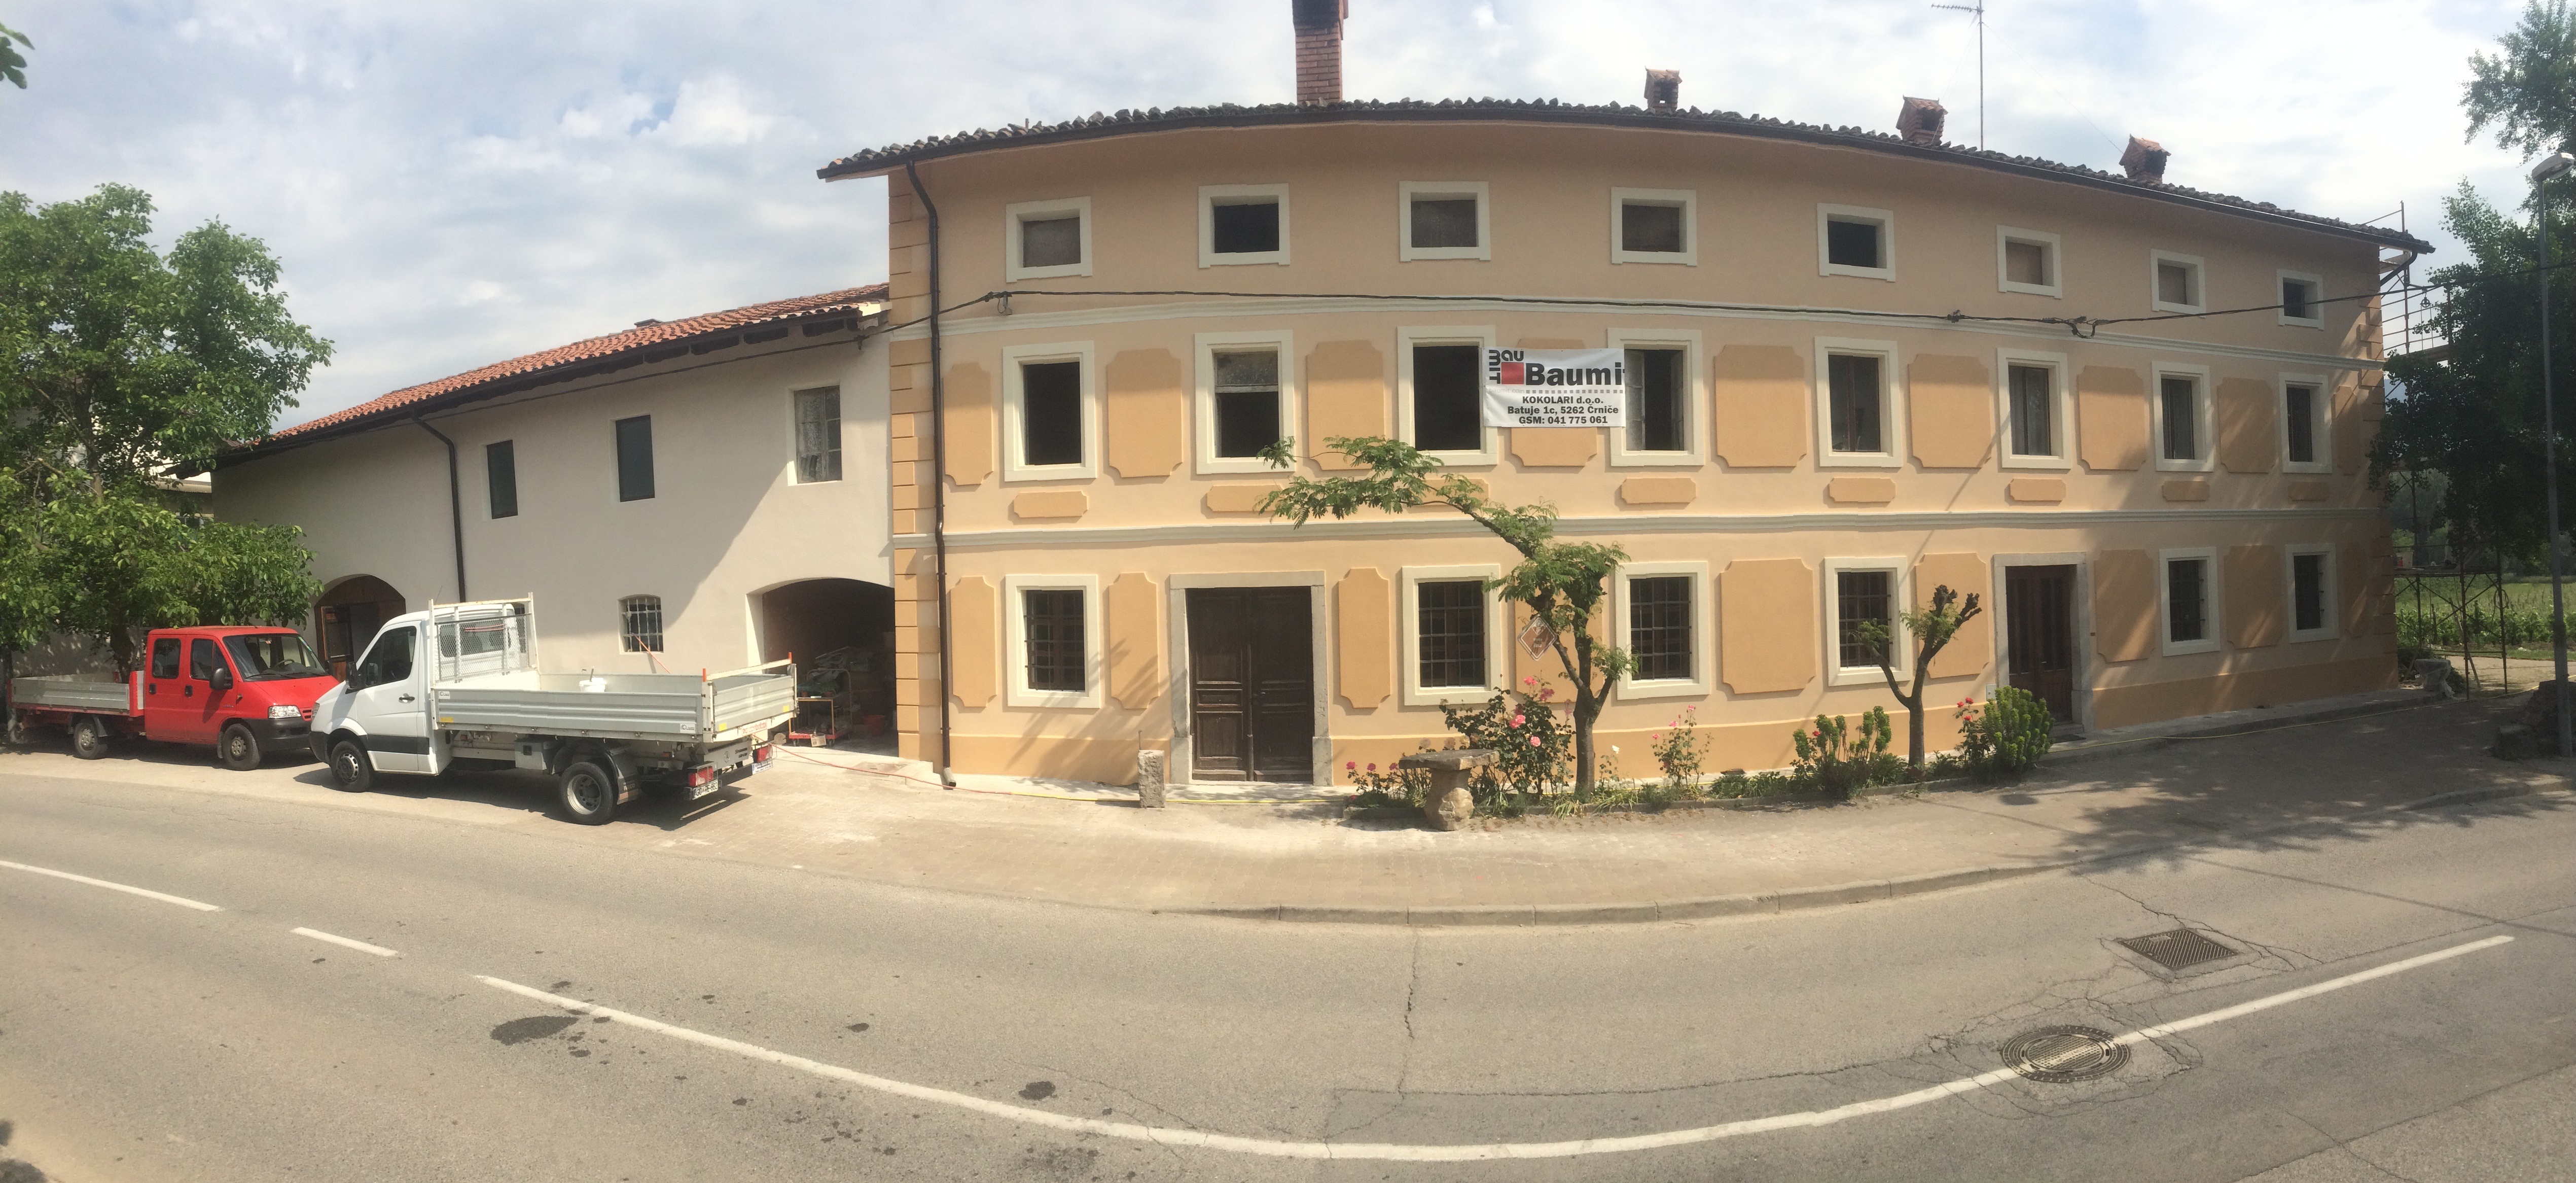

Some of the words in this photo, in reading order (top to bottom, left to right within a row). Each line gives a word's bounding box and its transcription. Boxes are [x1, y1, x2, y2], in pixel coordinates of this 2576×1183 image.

[1508, 406, 1540, 415] Batuje
[1543, 406, 1558, 415] 1c,
[1587, 403, 1619, 414] Črniče
[1519, 416, 1545, 424] GSM:
[1548, 416, 1566, 424] 041
[1568, 416, 1587, 424] 775
[1589, 415, 1608, 424] 061
